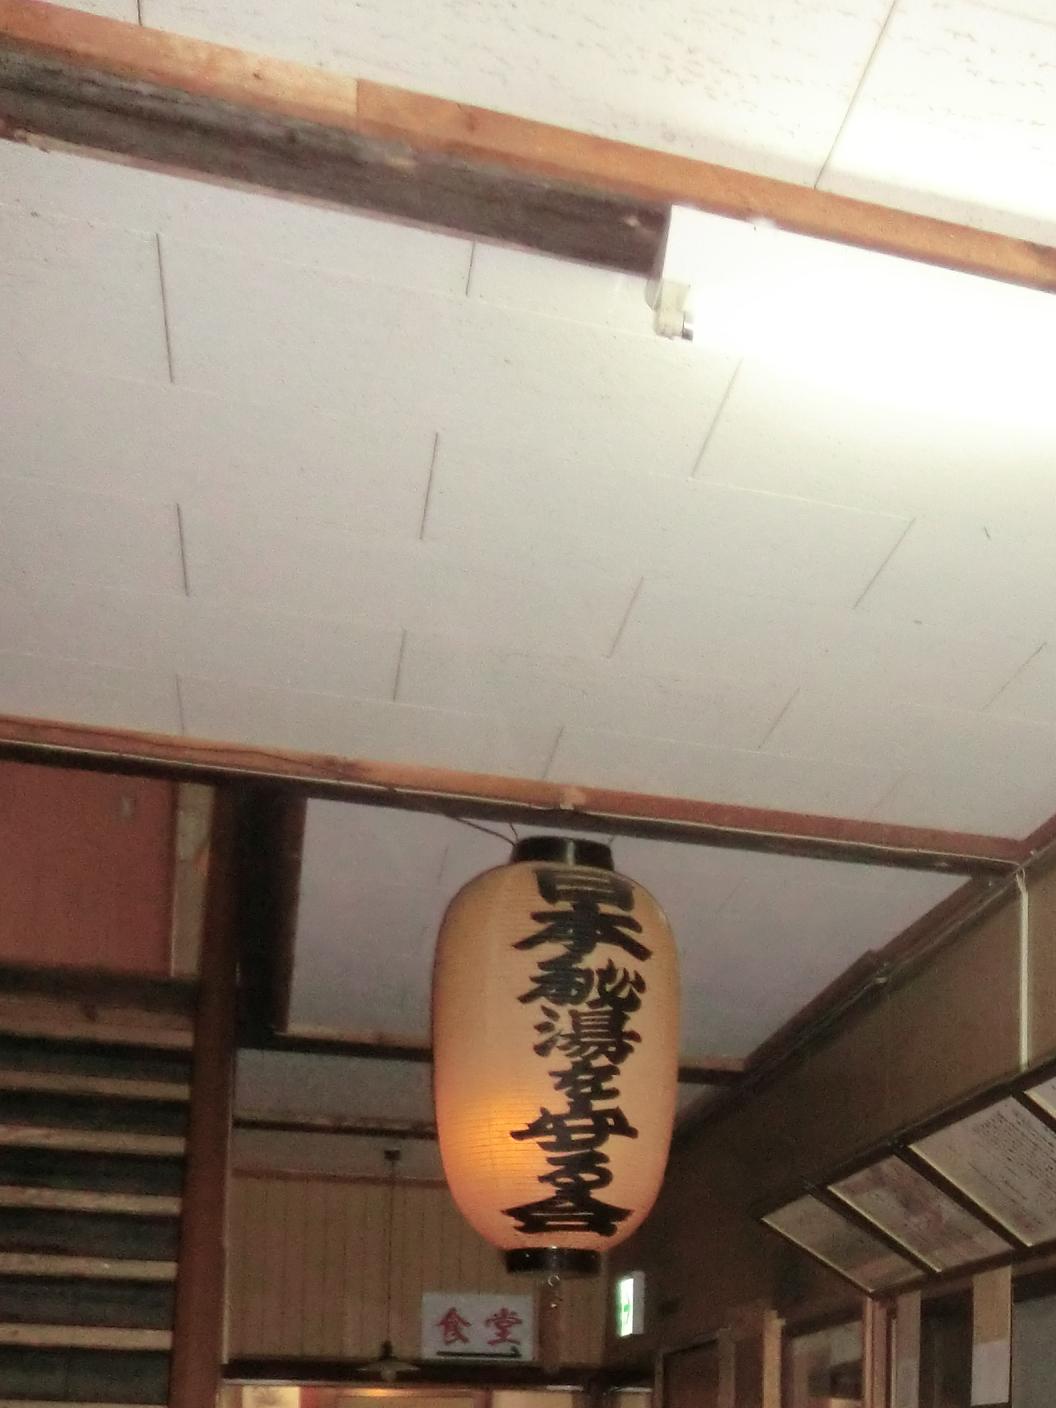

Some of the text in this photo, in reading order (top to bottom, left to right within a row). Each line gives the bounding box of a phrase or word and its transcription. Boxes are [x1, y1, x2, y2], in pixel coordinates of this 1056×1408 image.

[501, 869, 652, 1238] 日本秘湯を守る会
[435, 1306, 524, 1347] 食堂
